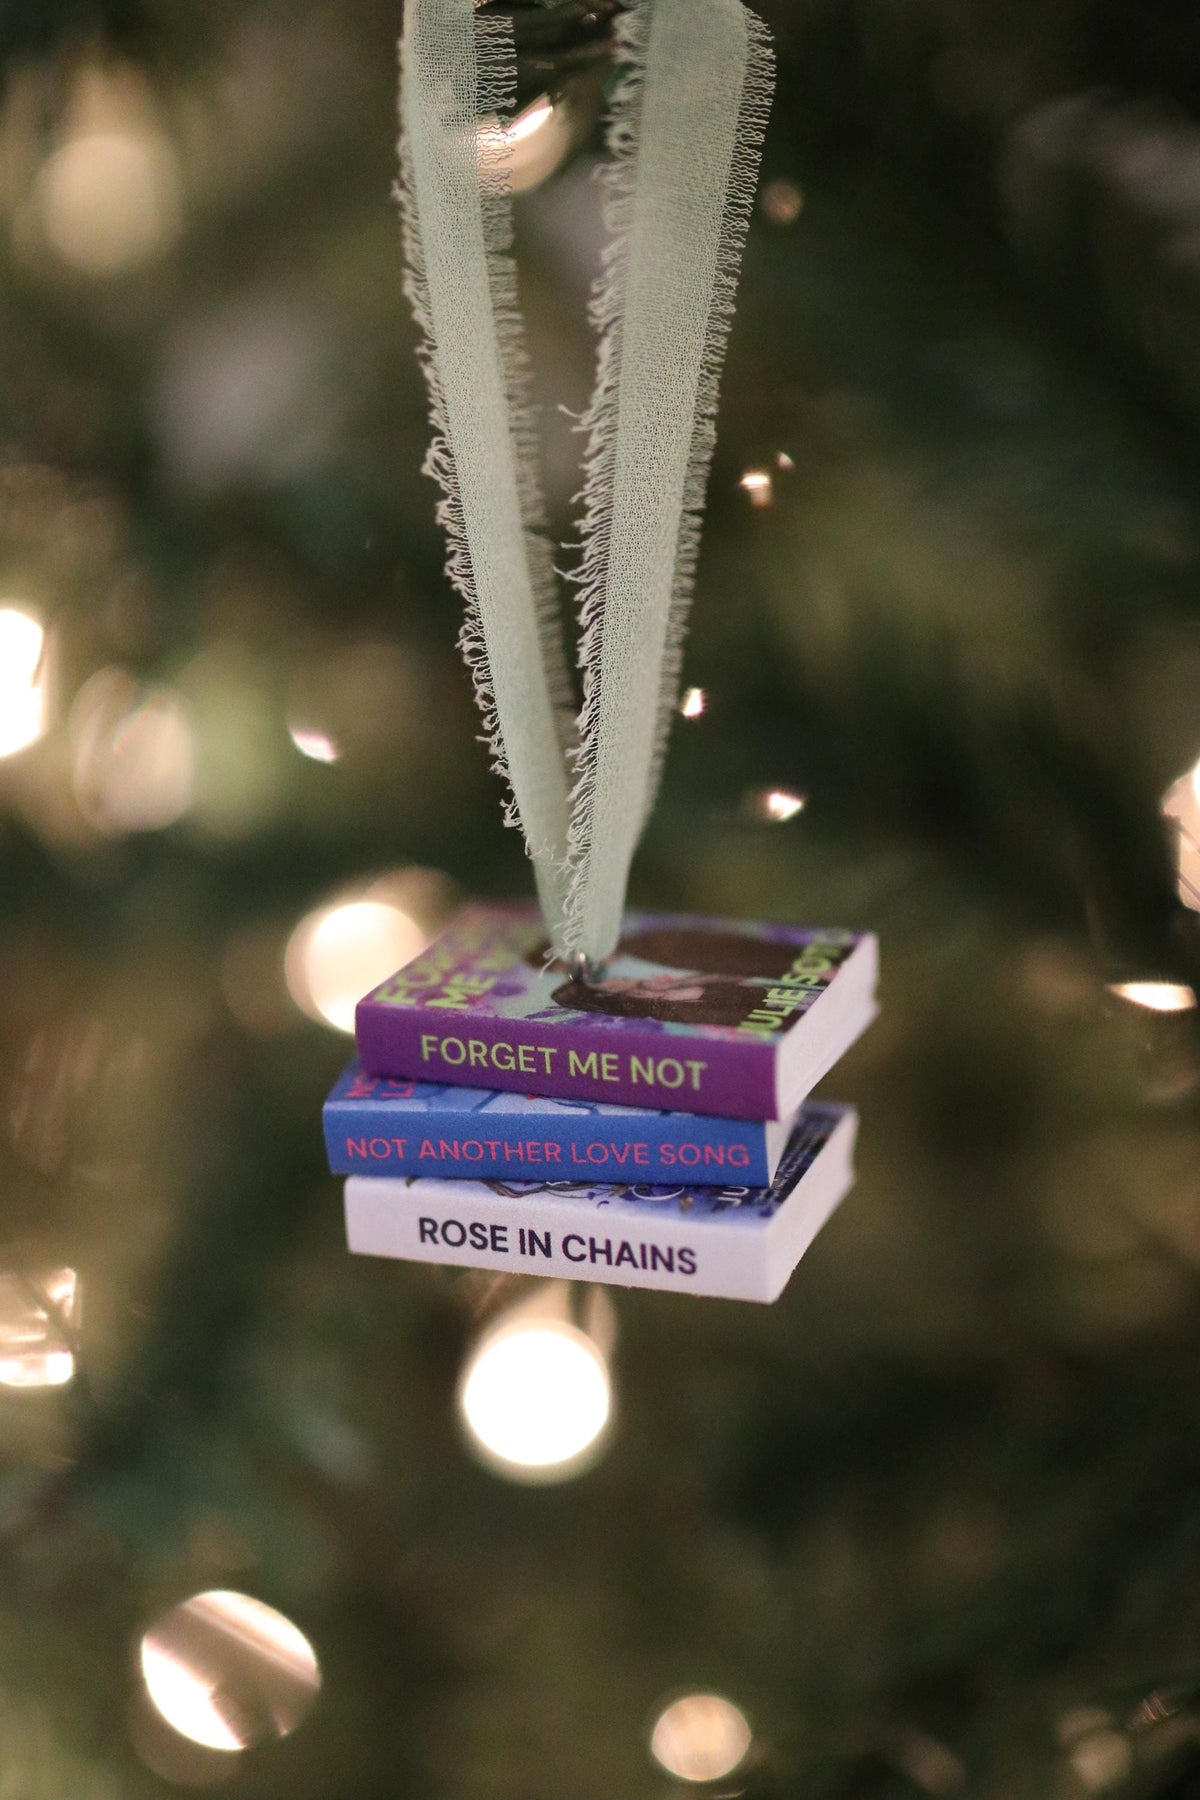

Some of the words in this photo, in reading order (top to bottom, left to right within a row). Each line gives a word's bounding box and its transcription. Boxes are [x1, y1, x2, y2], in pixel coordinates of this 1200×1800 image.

[420, 1034, 558, 1074] FORGET
[568, 1050, 620, 1082] ME
[630, 1055, 708, 1091] NOT
[346, 1137, 407, 1159] NOT
[418, 1138, 561, 1164] ANOTHER
[571, 1142, 648, 1165] LOVE
[659, 1143, 750, 1167] SONG
[418, 1217, 509, 1253] ROSE
[519, 1228, 552, 1258] IN
[561, 1233, 698, 1276] CHAINS
